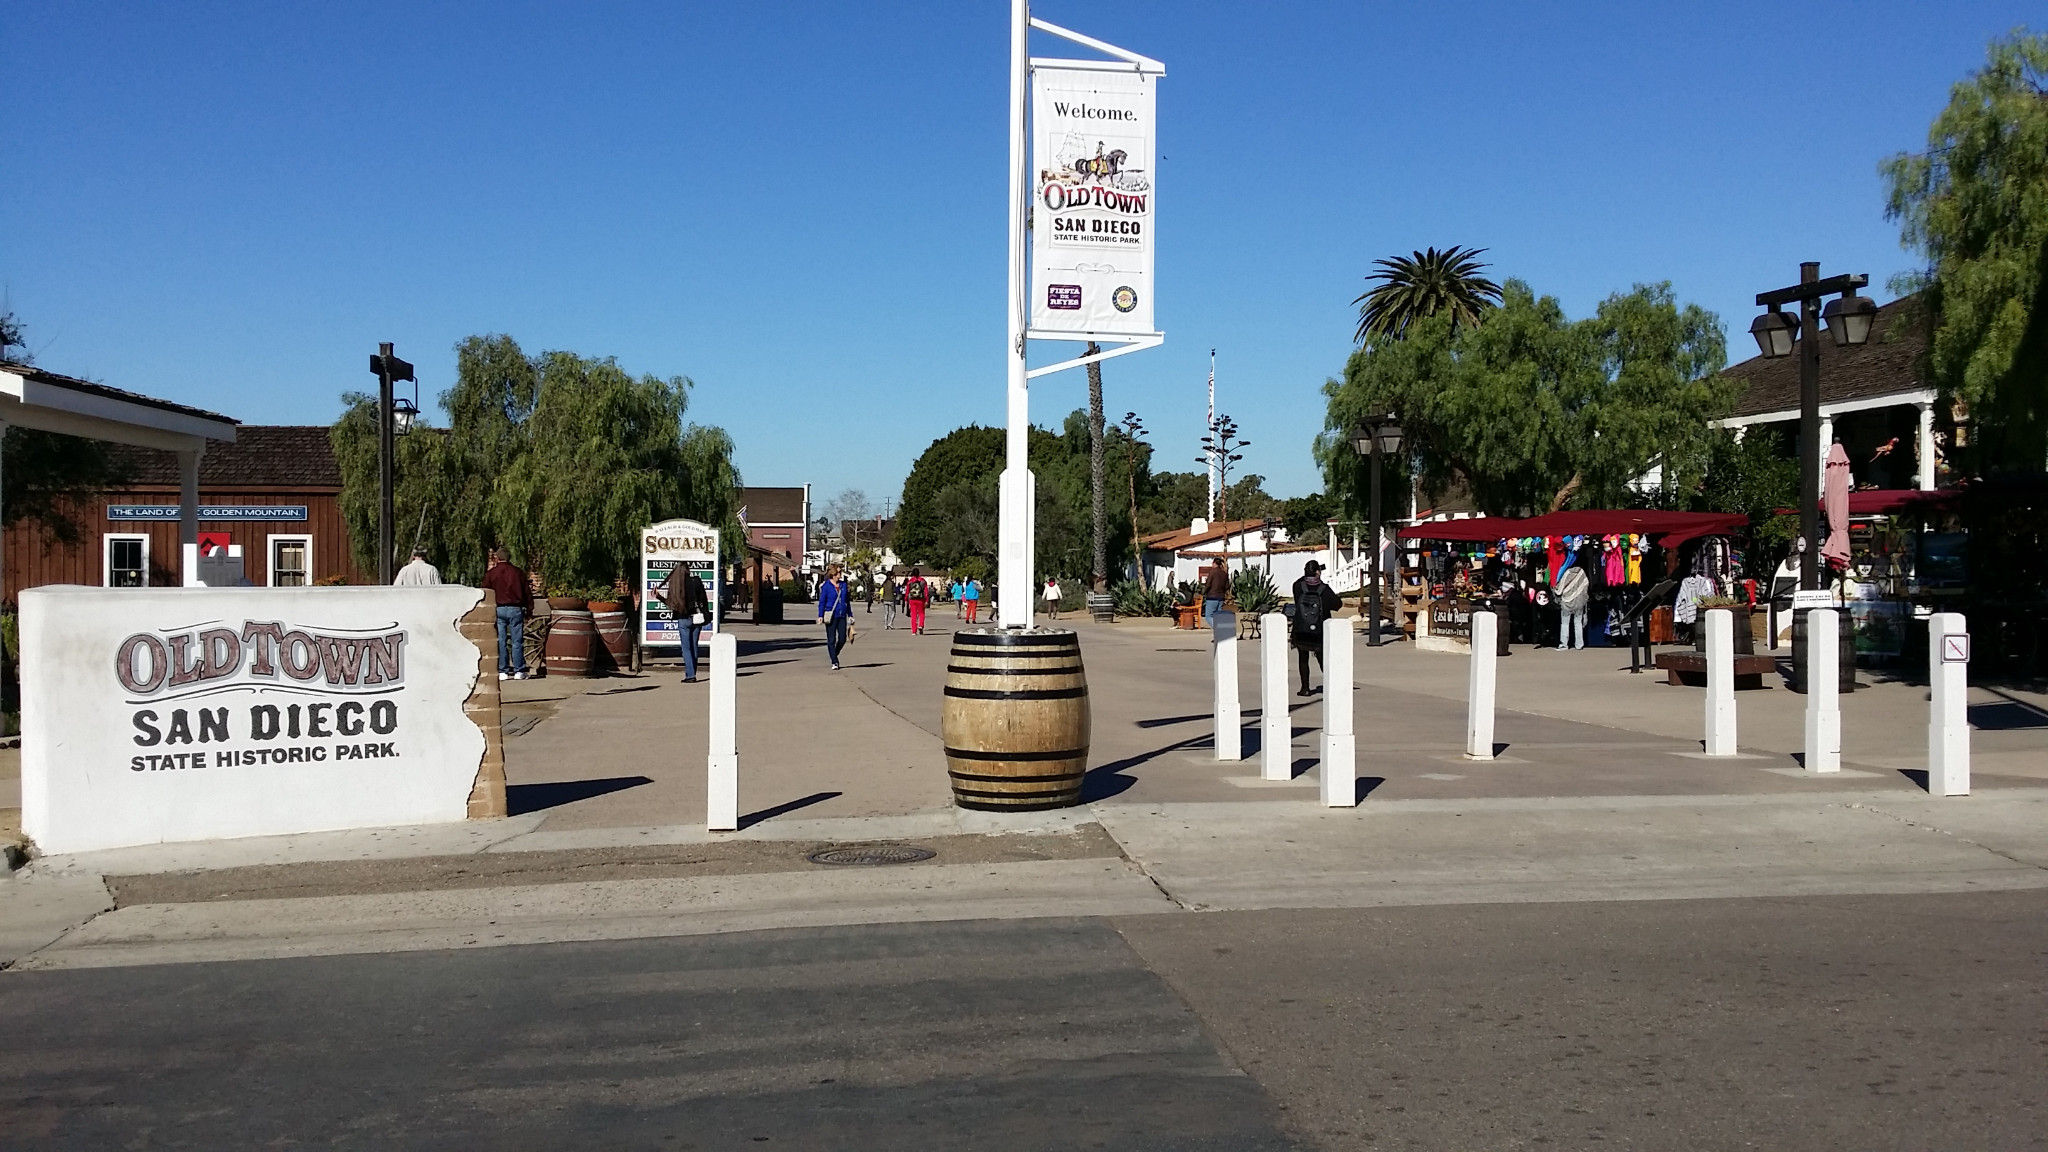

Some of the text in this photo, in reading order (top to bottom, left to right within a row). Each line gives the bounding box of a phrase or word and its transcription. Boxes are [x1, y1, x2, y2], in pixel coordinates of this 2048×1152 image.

[1054, 102, 1138, 122] Welcome.
[1044, 183, 1147, 213] OLD TOWN
[1054, 217, 1141, 235] SAN DIEGO
[1081, 235, 1118, 243] HISTORIC
[113, 508, 134, 516] THE
[135, 508, 164, 516] LAND
[165, 508, 179, 516] OF
[202, 508, 243, 516] GOLDEN
[645, 535, 715, 554] SQUARE
[652, 561, 709, 569] RESTARANT
[116, 621, 404, 693] OLD TOWN
[132, 700, 398, 747] SAN DIEGO
[131, 742, 401, 771] STATE HISTORIC PARK.
